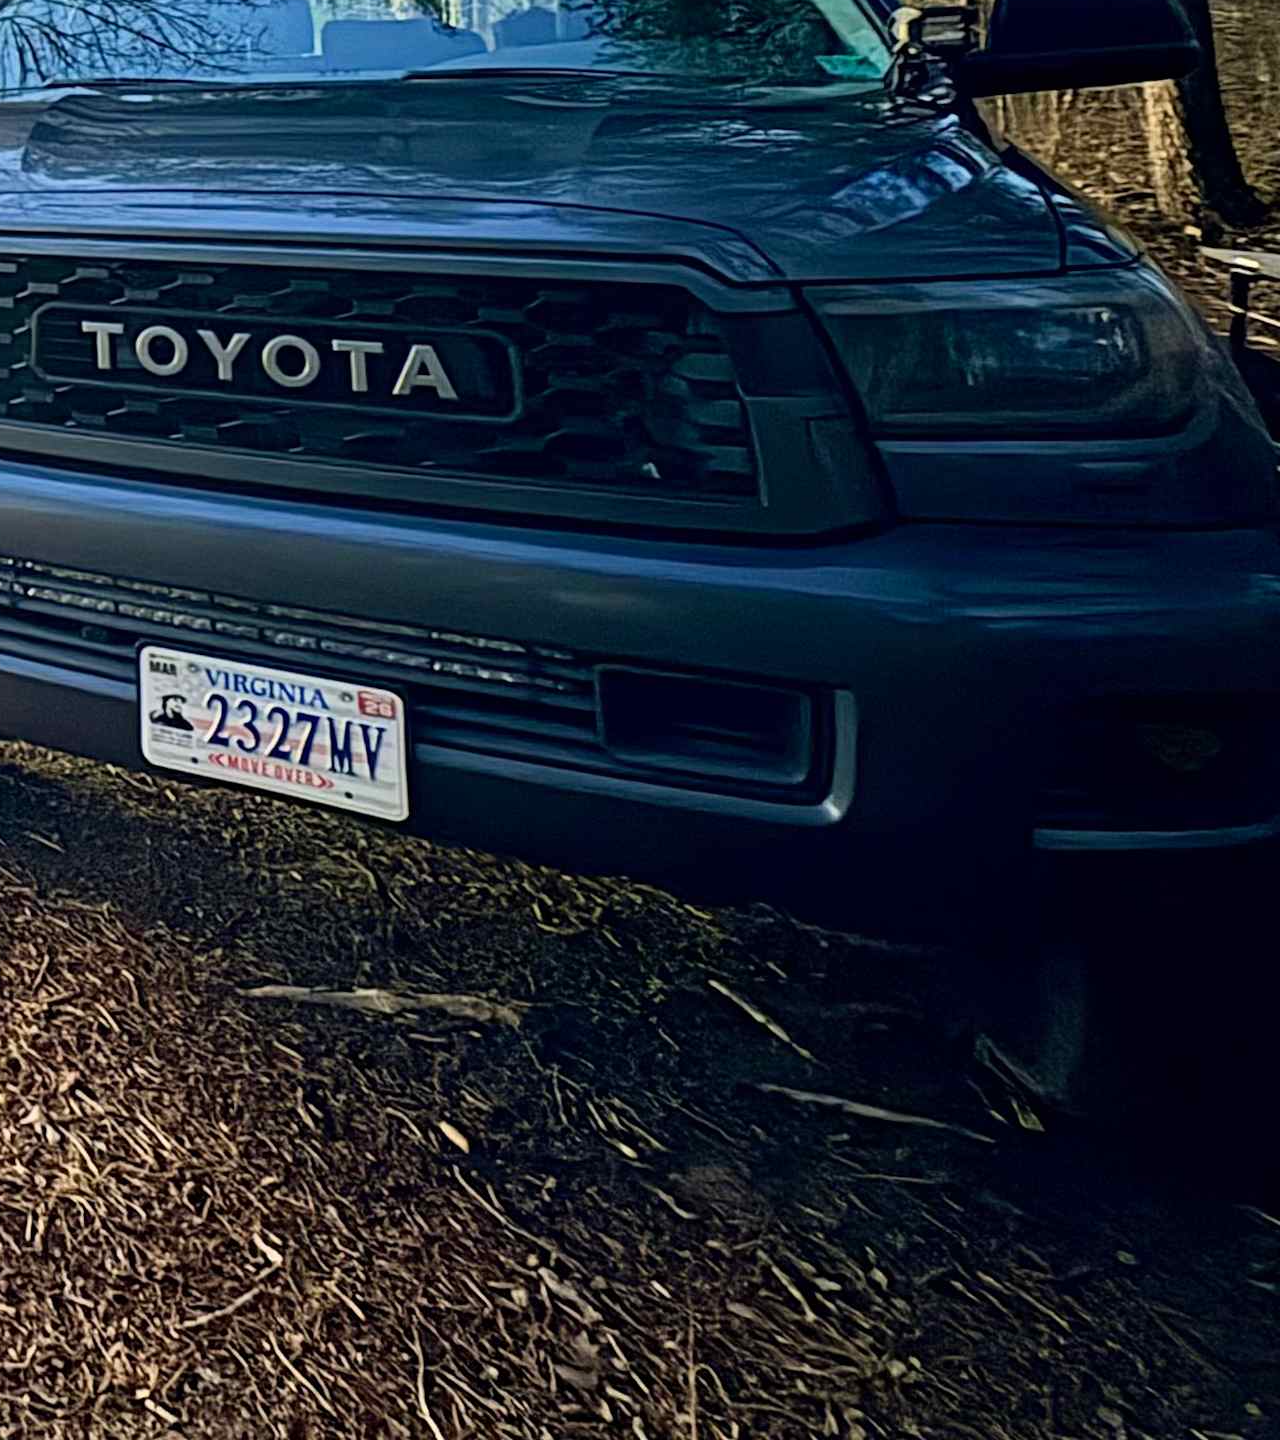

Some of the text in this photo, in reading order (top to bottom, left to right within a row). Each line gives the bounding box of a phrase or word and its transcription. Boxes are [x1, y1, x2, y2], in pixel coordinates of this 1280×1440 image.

[81, 320, 458, 400] TOYOTA
[205, 667, 330, 710] VIRGINIA
[206, 693, 387, 782] 2327MV
[227, 754, 314, 787] MOVE OVER
